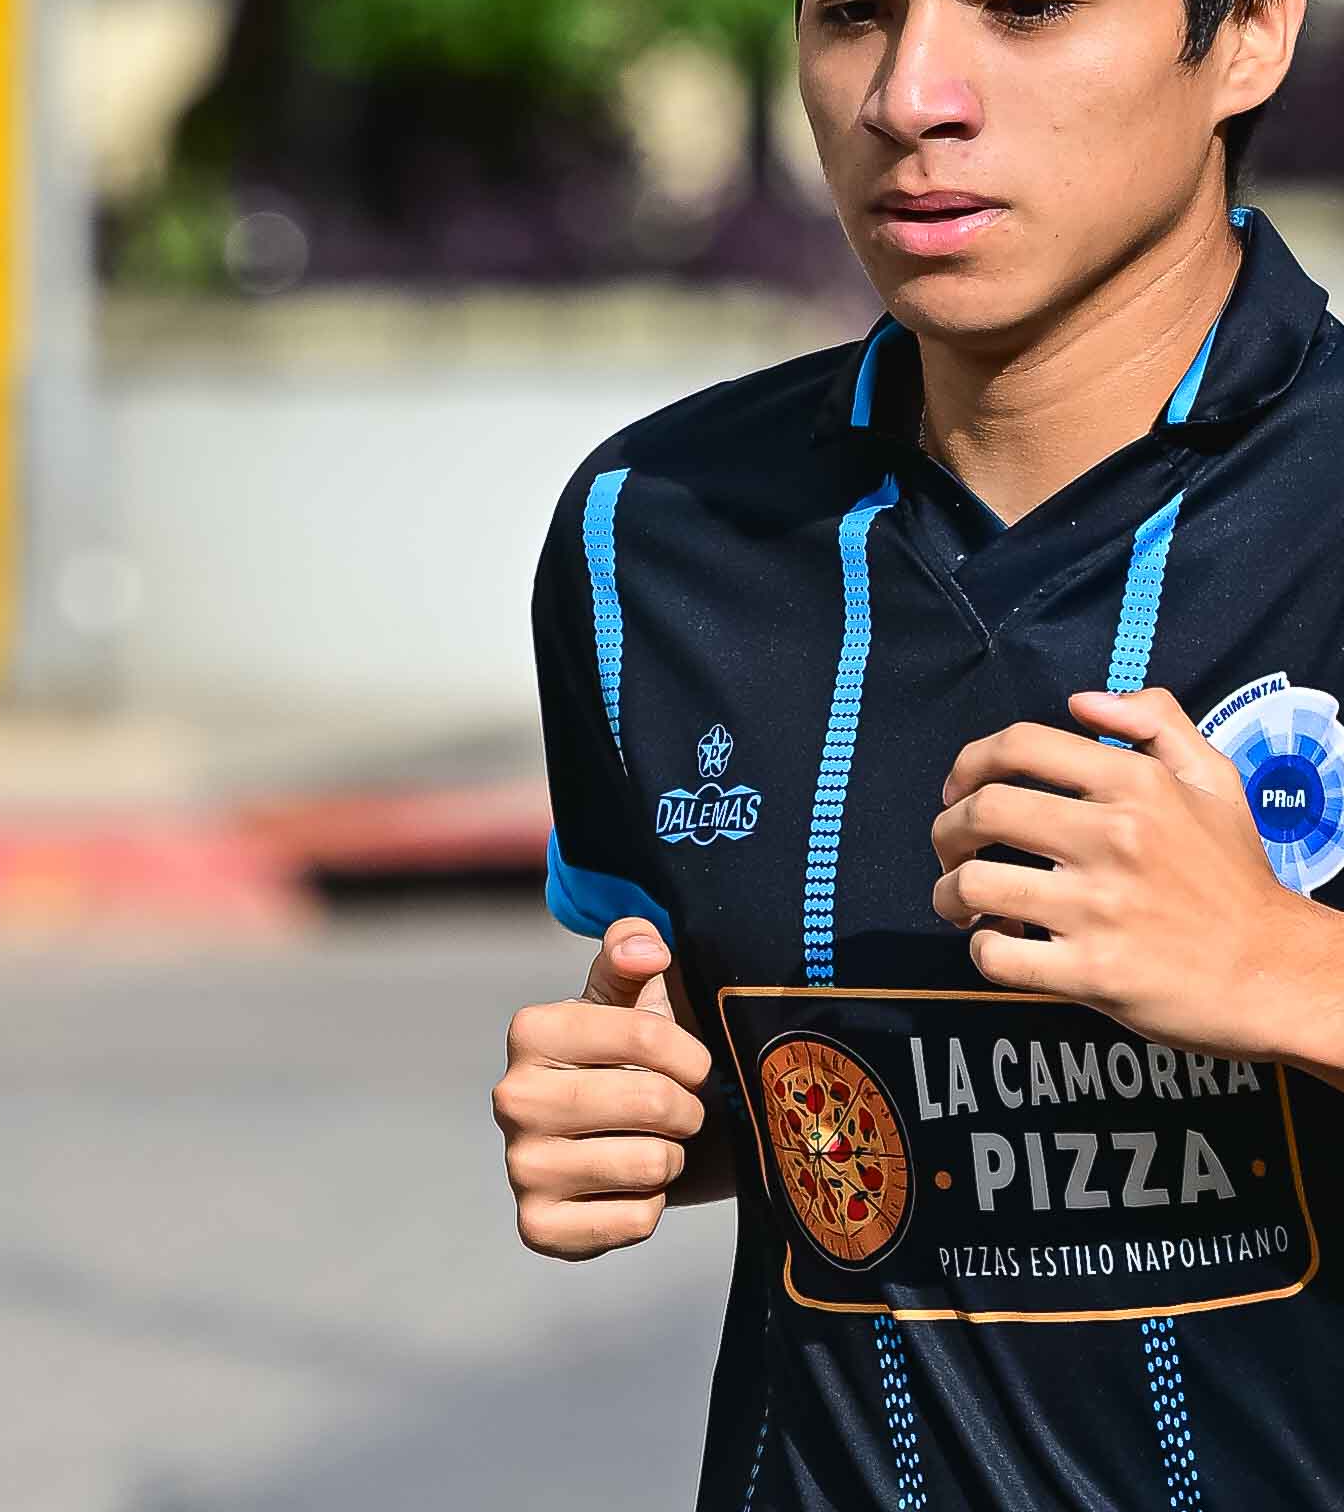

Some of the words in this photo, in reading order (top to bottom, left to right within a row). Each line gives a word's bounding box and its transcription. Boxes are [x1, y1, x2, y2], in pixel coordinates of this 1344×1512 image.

[656, 794, 762, 833] DALEMAS
[910, 1037, 979, 1120] LA
[992, 1038, 1261, 1109] CAMORRA
[970, 1129, 1237, 1211] PIZZA
[939, 1246, 1020, 1278] PIZZAS
[1030, 1243, 1114, 1278] ESTILO
[1125, 1225, 1288, 1273] NAPOLITANO
